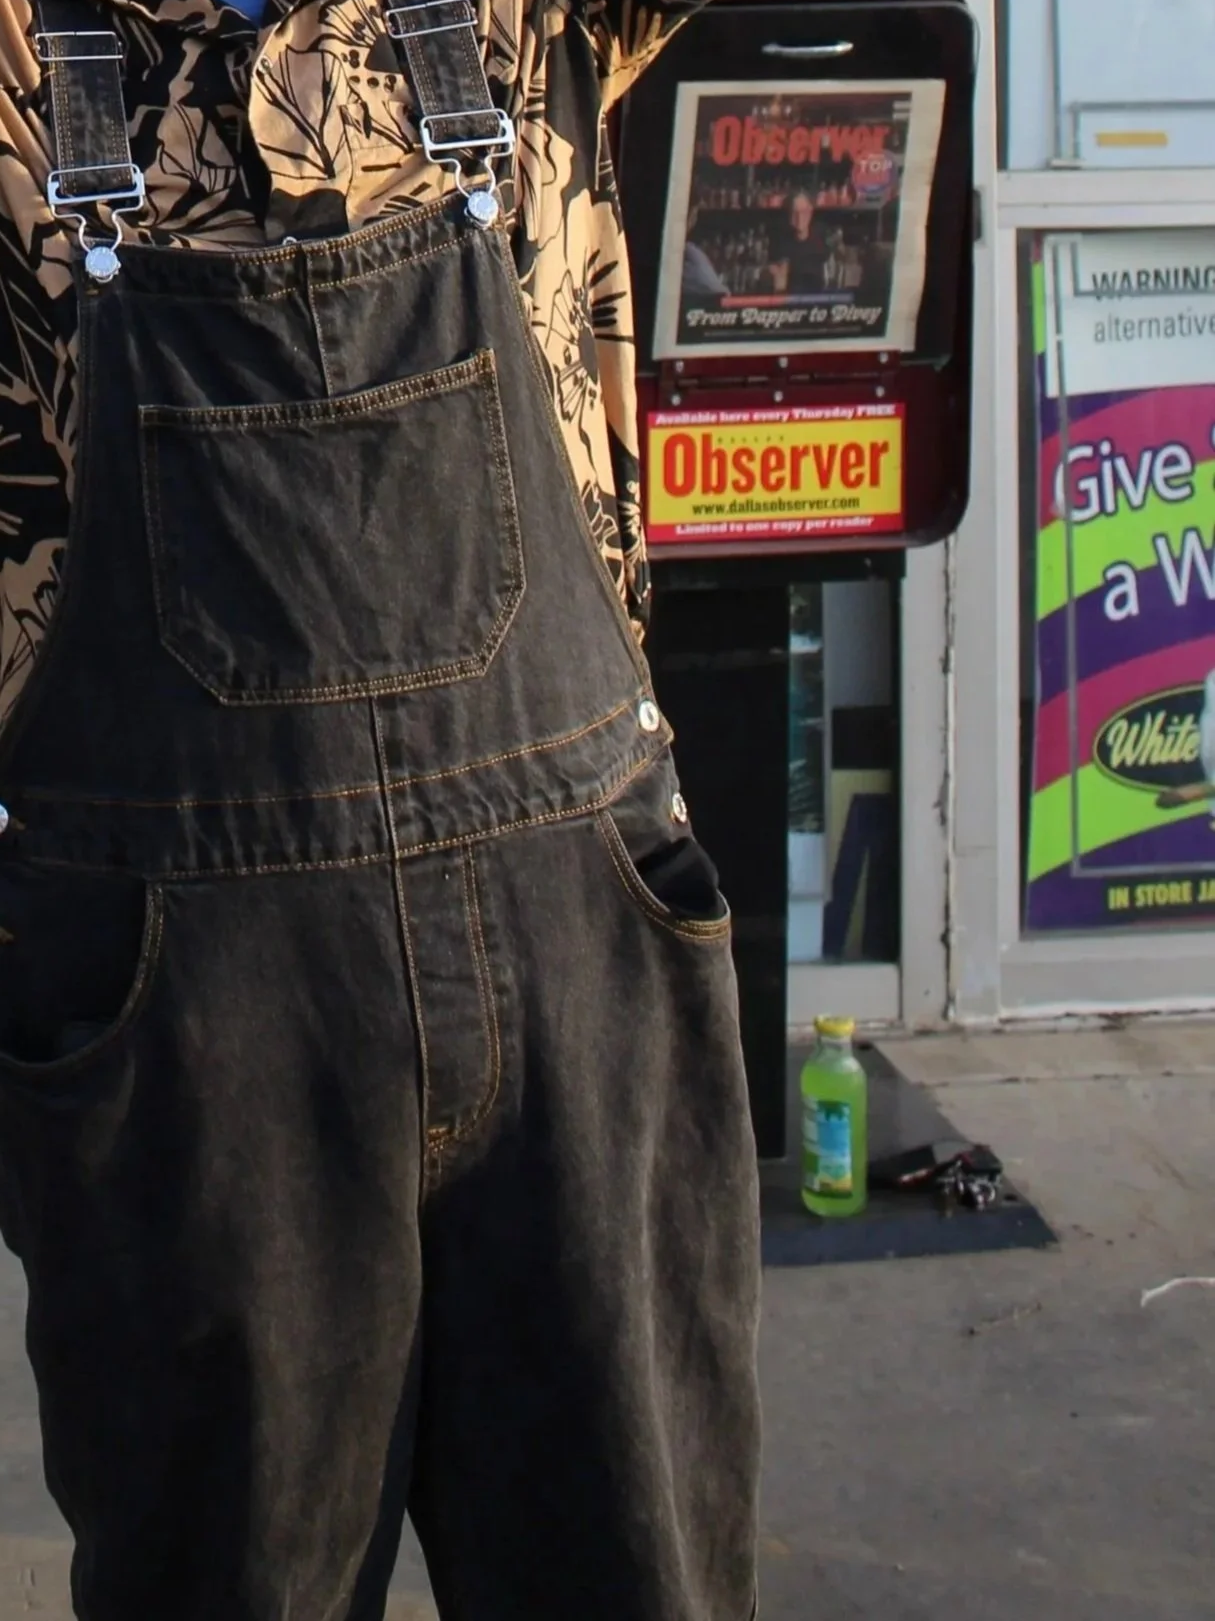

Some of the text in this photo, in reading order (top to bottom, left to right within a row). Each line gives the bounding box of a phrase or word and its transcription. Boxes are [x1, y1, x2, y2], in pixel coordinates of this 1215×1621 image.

[859, 159, 893, 173] TOP
[685, 308, 737, 328] From
[741, 306, 807, 329] Dapper
[809, 307, 828, 323] to
[656, 404, 896, 426] Available here every Thursday FREE
[663, 432, 890, 498] Observer
[1054, 439, 1194, 523] Give
[691, 496, 861, 516] www.dallasobserver.com
[675, 516, 874, 536] Limited to one copy per reader
[1103, 560, 1140, 622] a
[1105, 707, 1201, 771] White
[1107, 885, 1130, 911] IN
[1135, 880, 1193, 909] STORE
